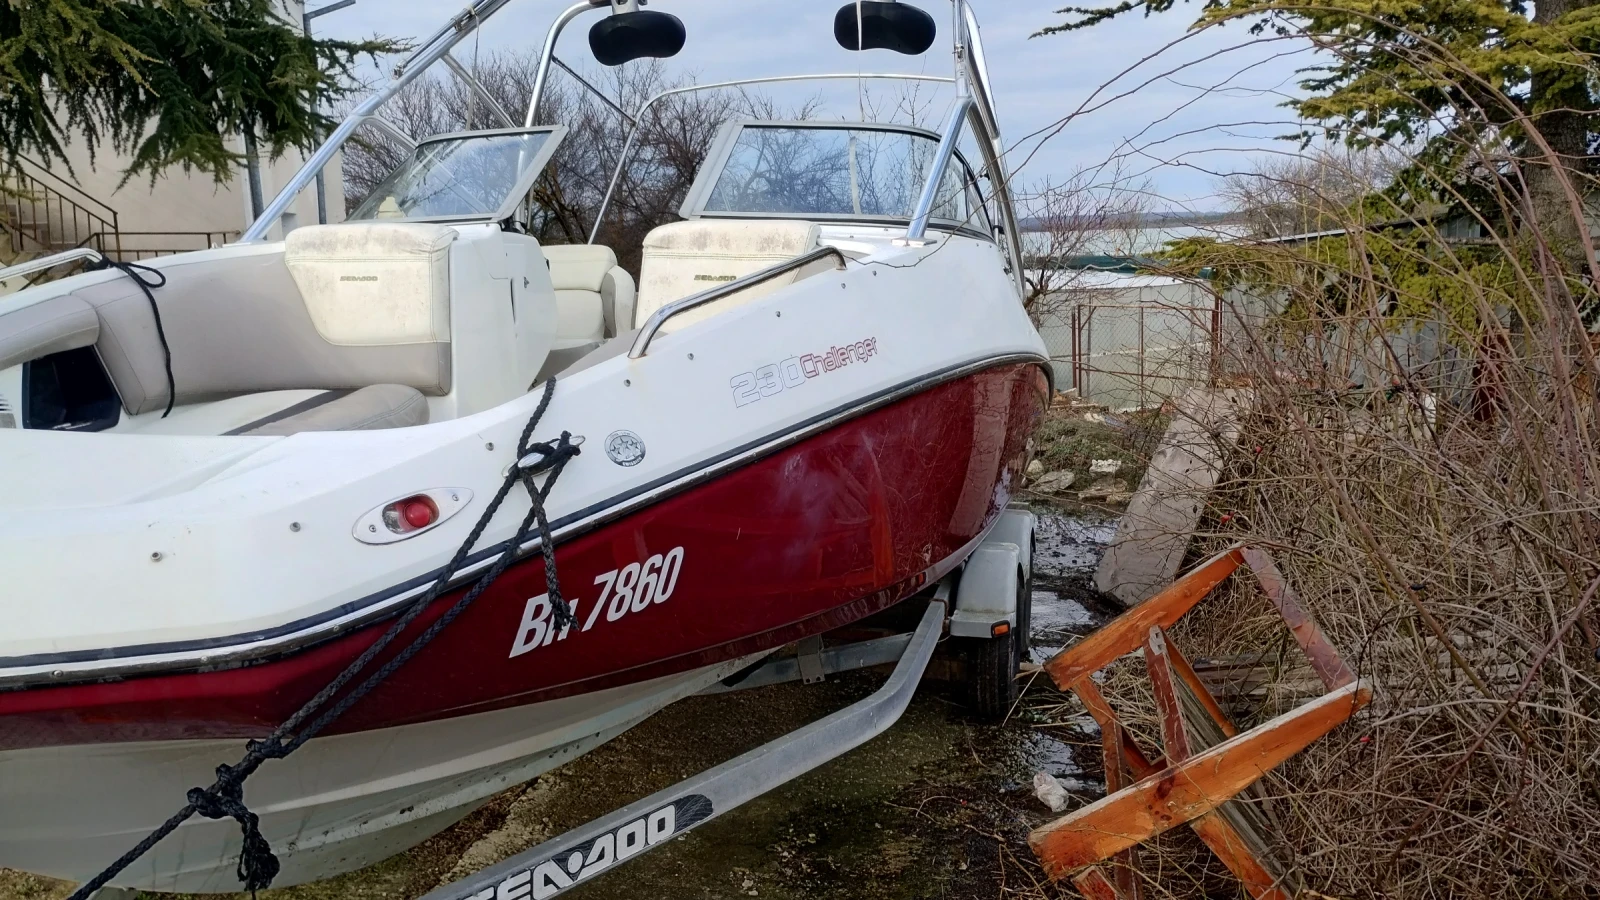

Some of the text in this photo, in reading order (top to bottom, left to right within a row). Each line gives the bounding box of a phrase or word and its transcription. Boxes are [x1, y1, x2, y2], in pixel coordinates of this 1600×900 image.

[730, 336, 878, 408] 230 Challenger
[581, 546, 684, 632] 7860
